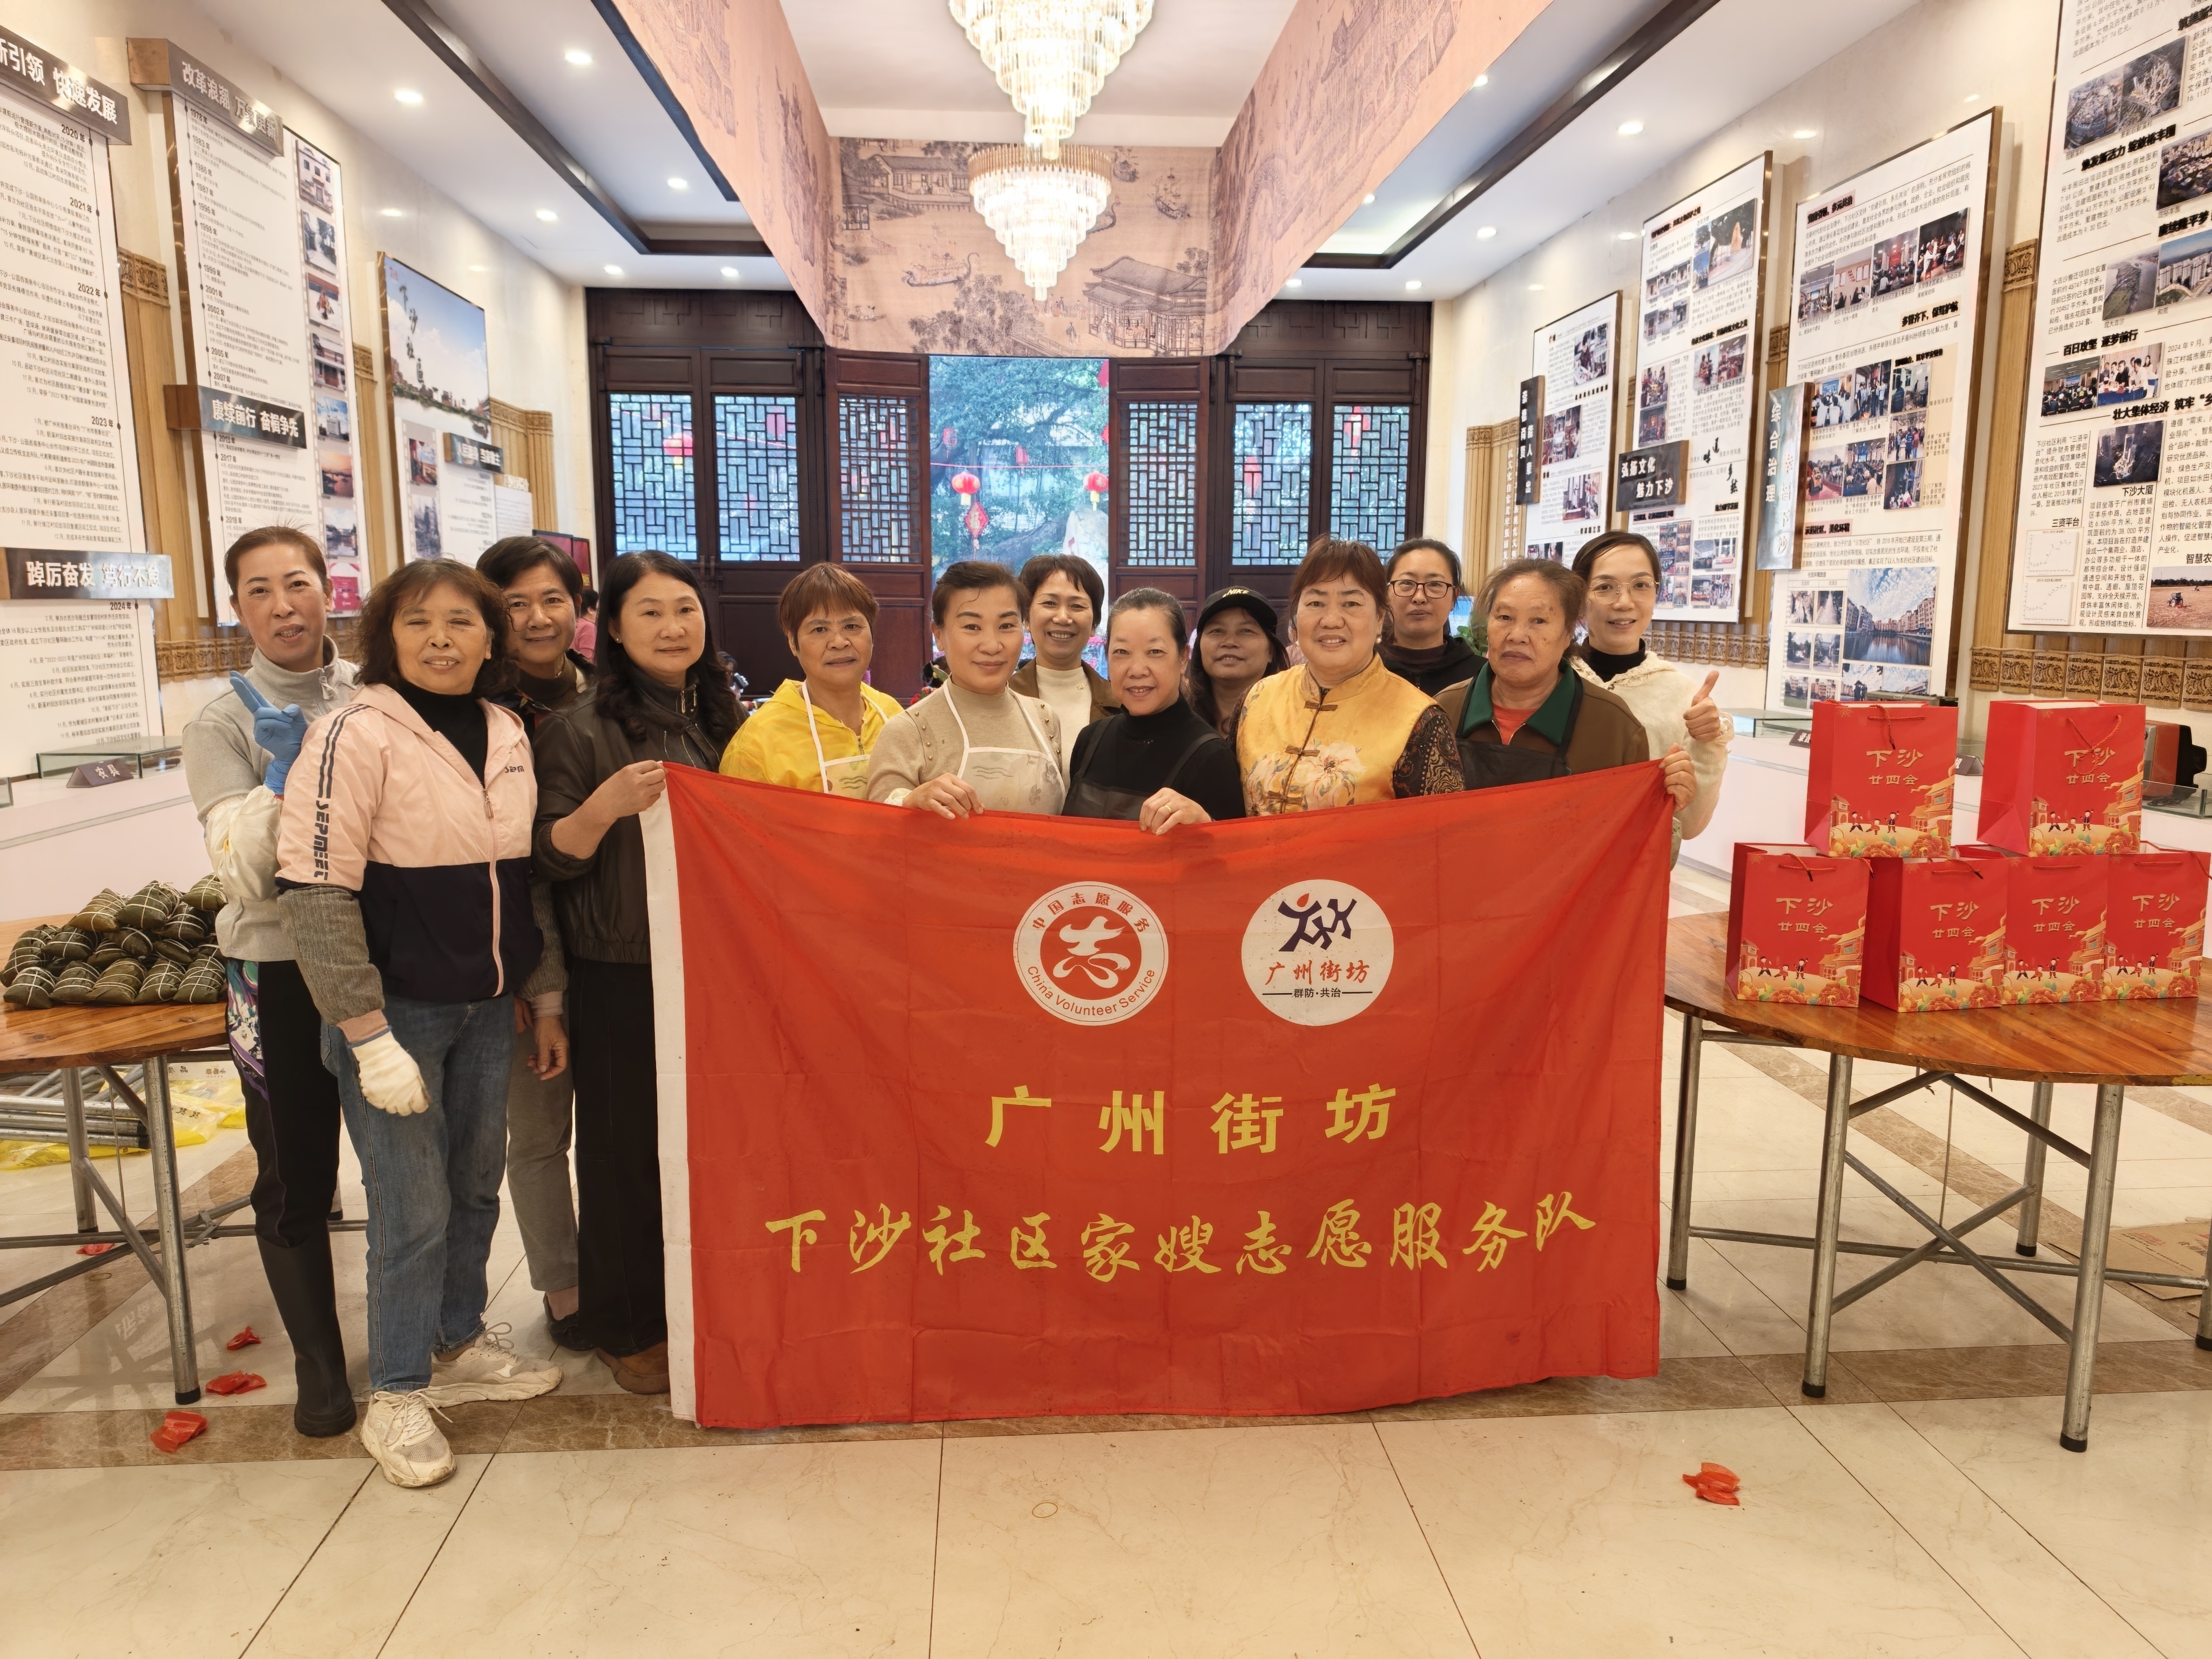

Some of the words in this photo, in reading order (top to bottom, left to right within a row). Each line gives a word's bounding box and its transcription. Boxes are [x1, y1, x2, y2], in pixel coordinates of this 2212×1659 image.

[182, 61, 230, 110] 改革浪潮
[52, 67, 118, 125] 快速发展
[70, 197, 92, 214] 2021年
[77, 282, 101, 298] 2022年
[2063, 338, 2098, 356] 百日攻坚
[2101, 329, 2139, 348] 逐梦前行
[212, 399, 257, 428] 赓续前行
[259, 410, 299, 437] 奋楫争先
[2112, 401, 2170, 421] 壮大集体经济
[91, 416, 113, 428] 2023年
[1765, 402, 1782, 502] 综合治理
[1636, 478, 1674, 499] 魅力下沙
[2122, 484, 2154, 496] 下沙大厦
[226, 516, 242, 524] 2018年
[2052, 517, 2080, 528] 三资平台
[26, 561, 96, 588] 踔厉奋发
[102, 563, 160, 588] 笃行不怠
[110, 602, 132, 611] 2024年
[1866, 748, 1924, 768] 下沙
[2065, 748, 2116, 767] 下沙
[1776, 896, 1833, 916] 下沙
[1930, 901, 1980, 921] 下沙
[2032, 895, 2080, 915] 下沙
[2133, 893, 2180, 912] 下沙
[1032, 892, 1149, 934] 中国志愿服务
[1265, 959, 1370, 985] 广州街坊
[1027, 965, 1053, 1000] China
[1055, 994, 1118, 1016] Volunteer
[1118, 968, 1156, 1009] Service
[984, 1083, 1398, 1155] 广州街坊
[765, 1192, 1595, 1282] 下沙社区家嫂志愿服务队
